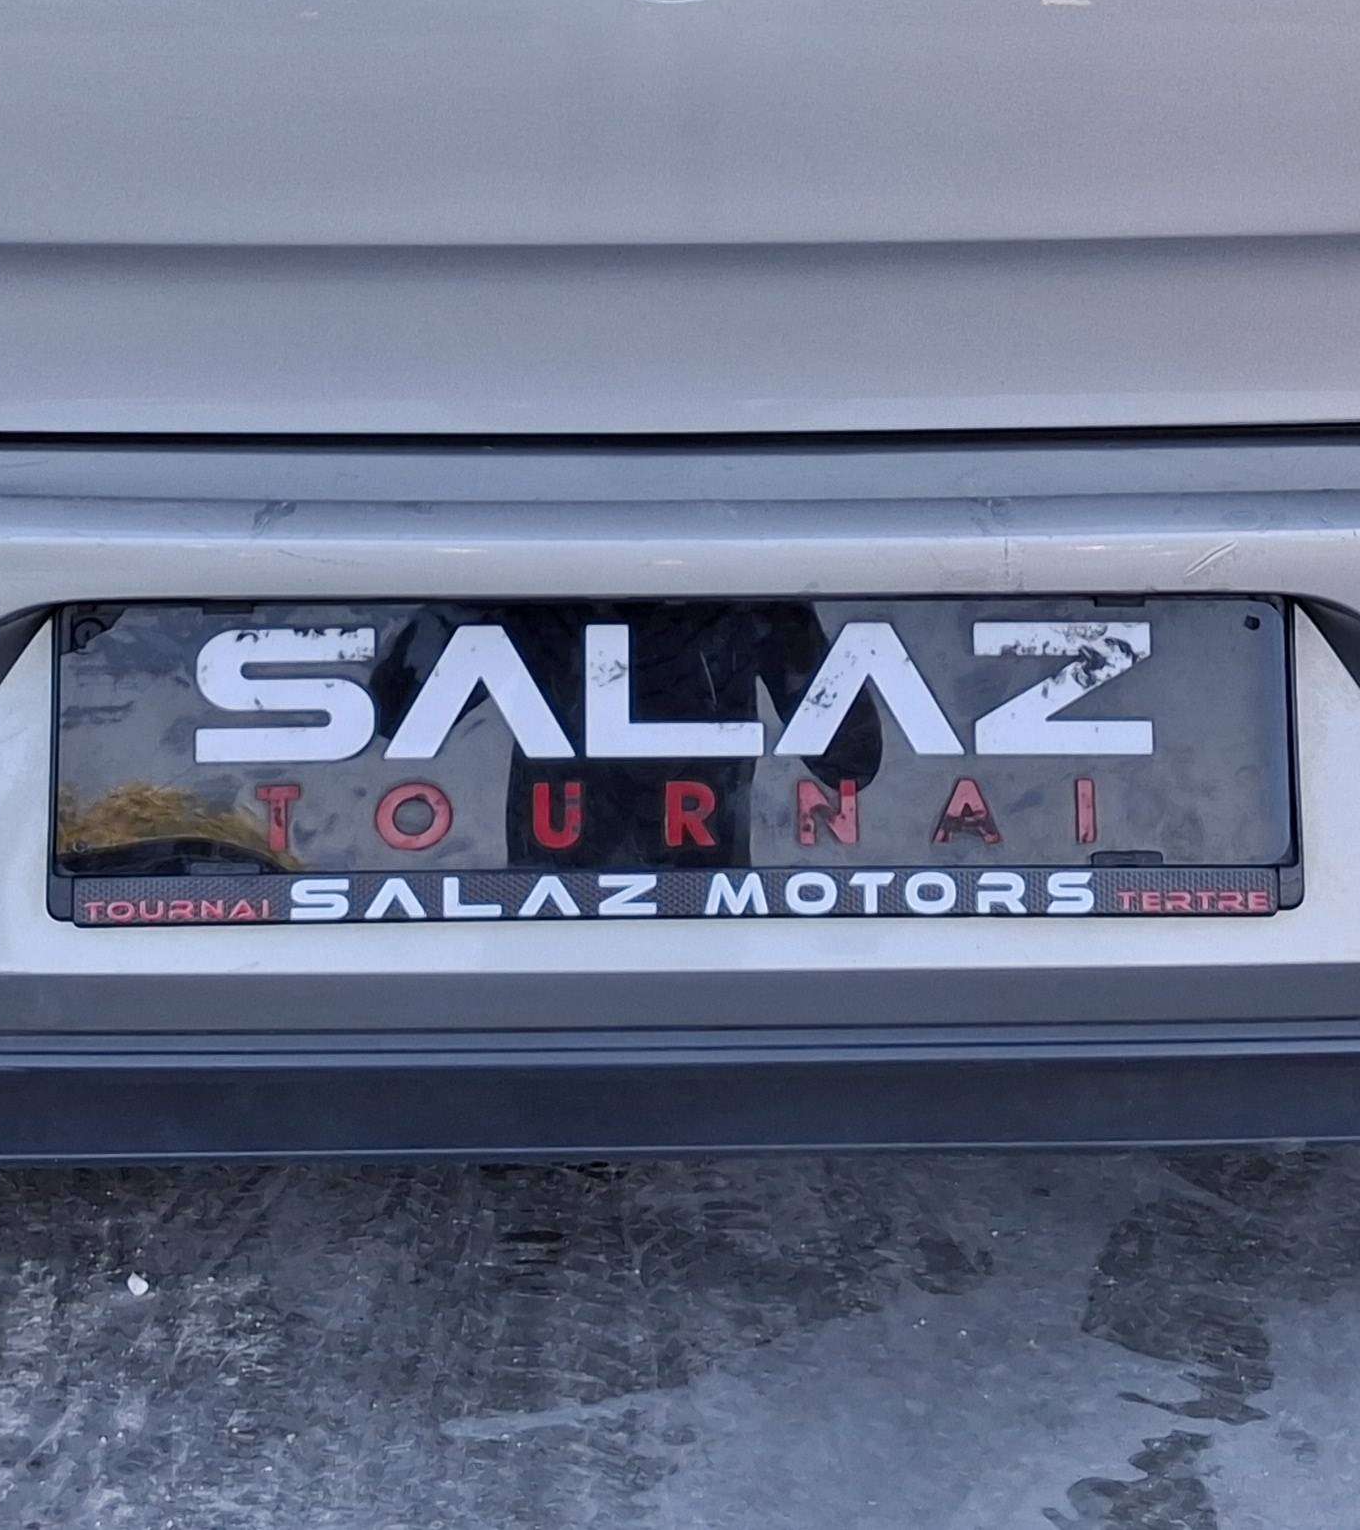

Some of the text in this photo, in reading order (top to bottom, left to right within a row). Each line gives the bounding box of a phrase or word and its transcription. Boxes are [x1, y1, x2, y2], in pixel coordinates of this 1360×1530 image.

[195, 622, 1153, 763] SALAZ
[256, 778, 1097, 850] TOURNAI
[83, 871, 1271, 922] TOURNAI SALAZ MOTORS TERTRE
